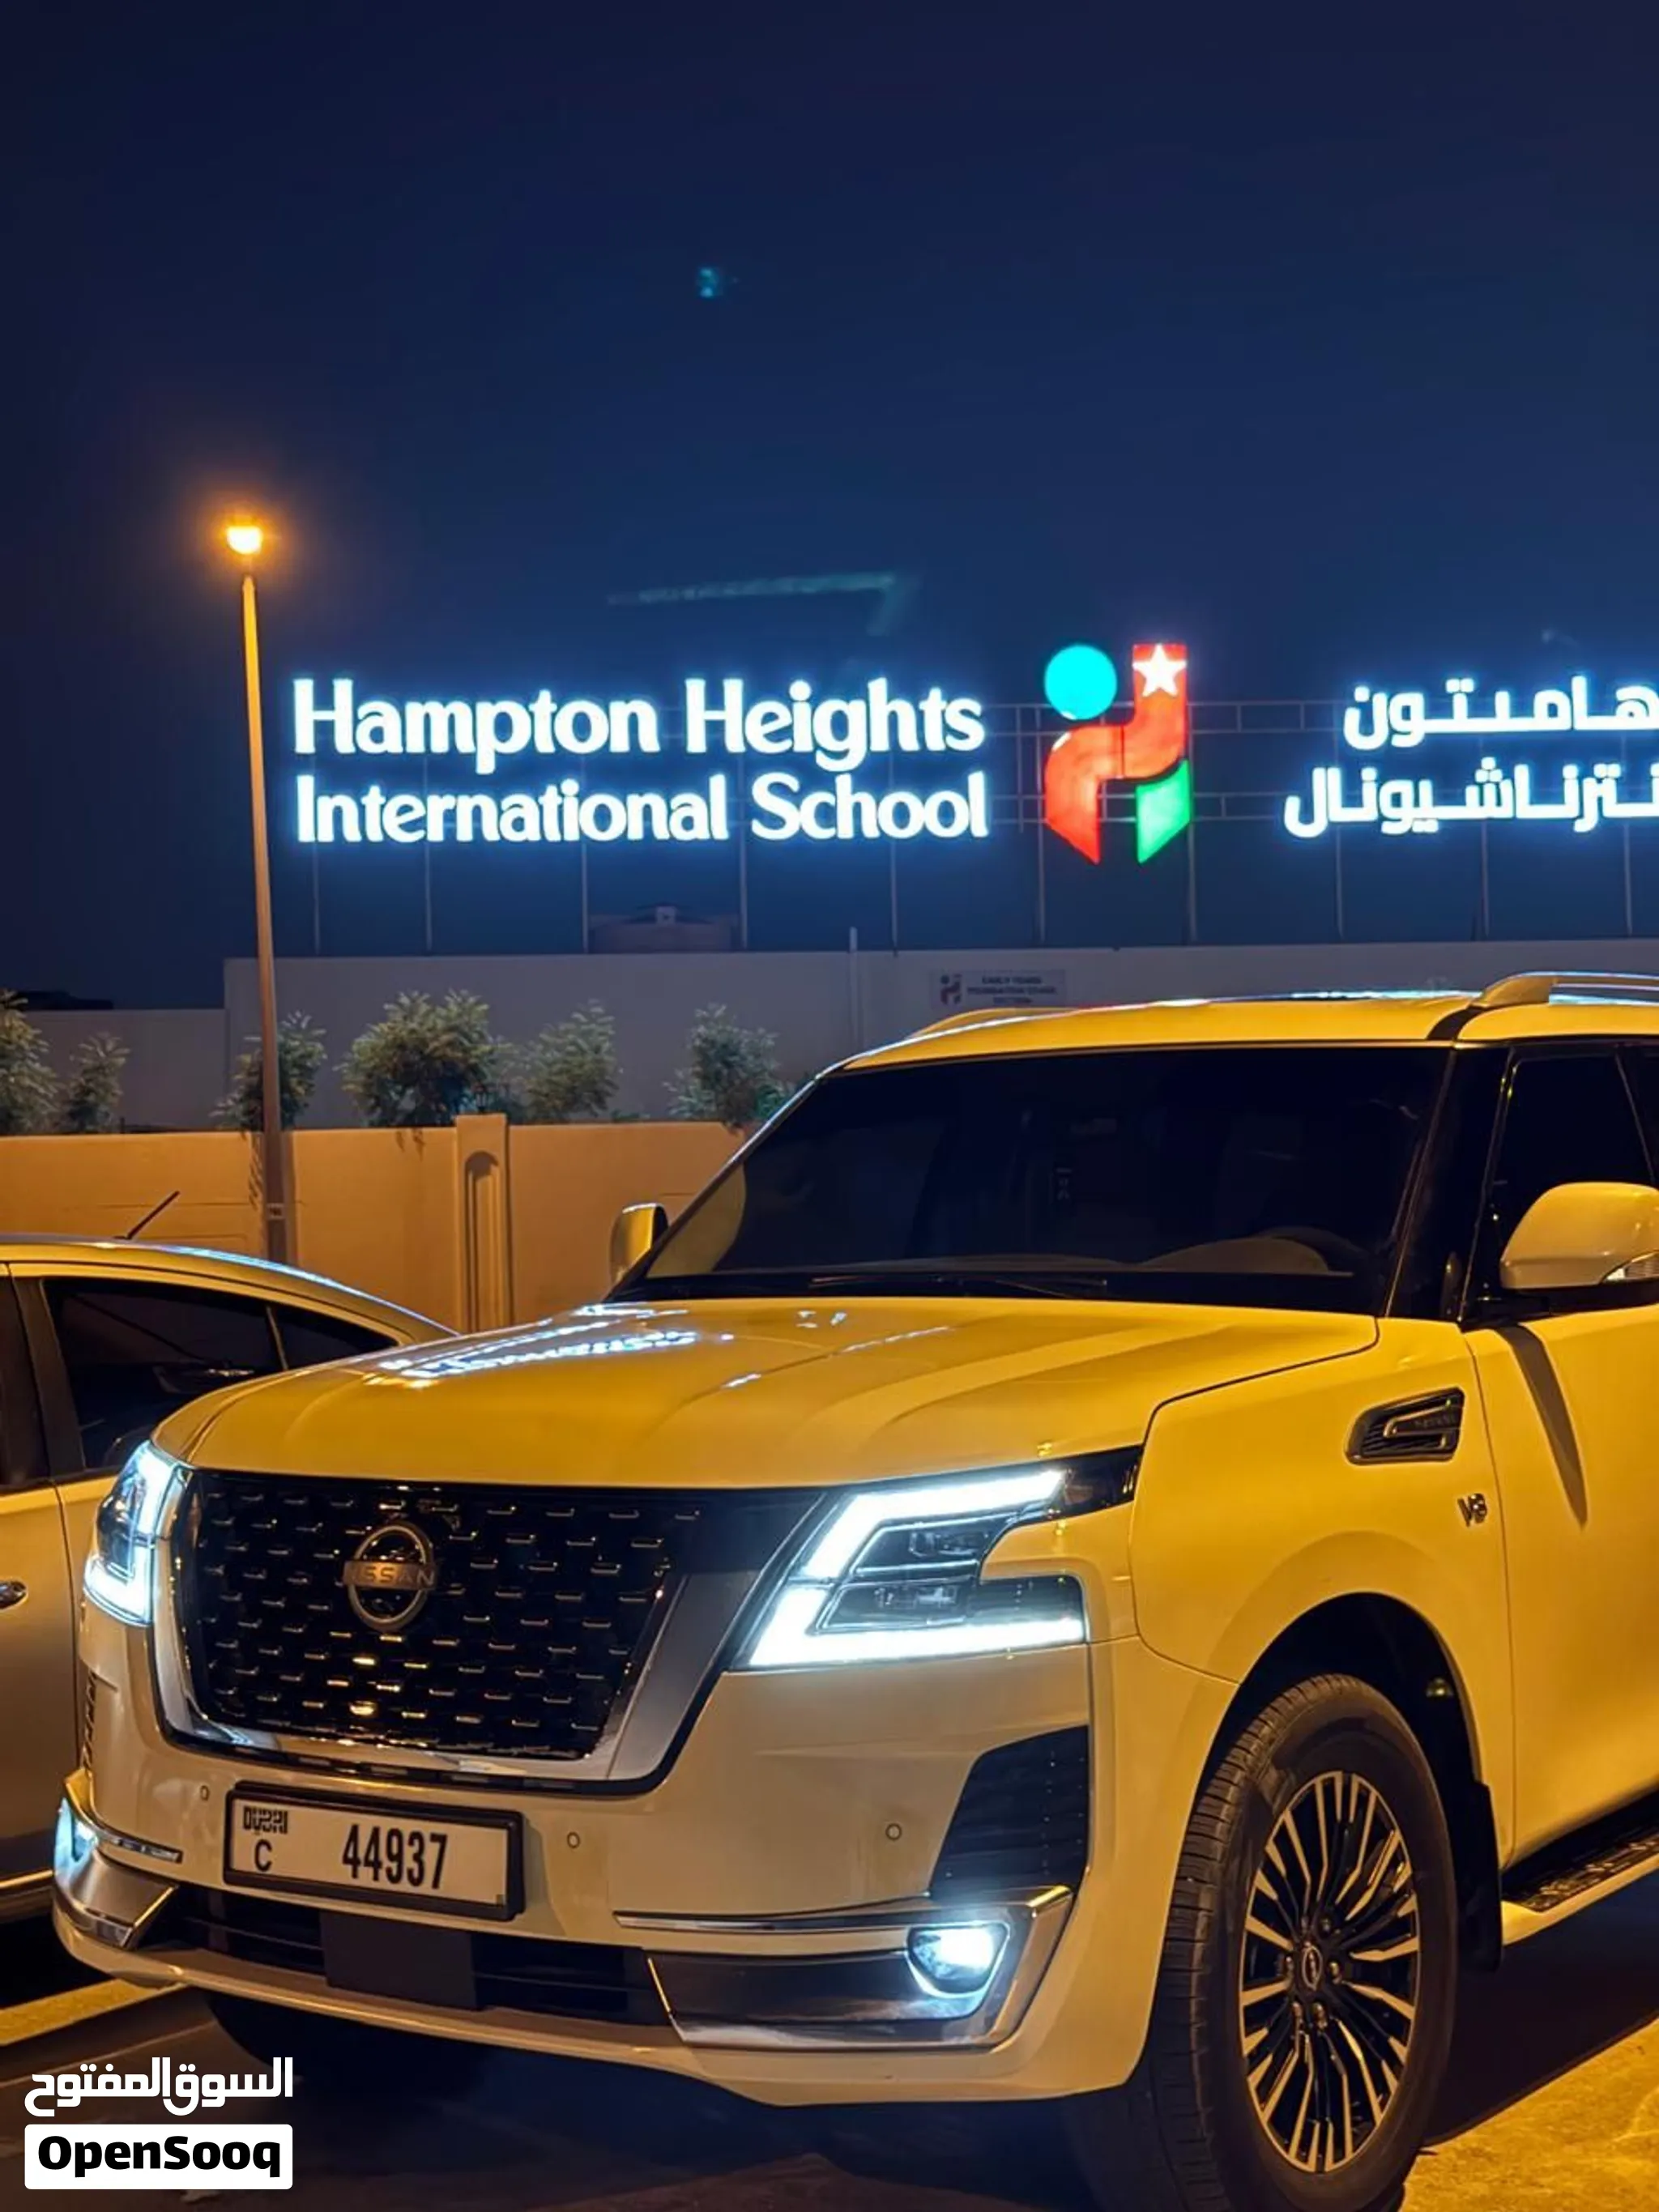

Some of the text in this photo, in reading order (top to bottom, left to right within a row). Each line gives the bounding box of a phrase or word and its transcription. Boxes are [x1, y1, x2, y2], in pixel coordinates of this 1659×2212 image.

[294, 677, 985, 774] Hampton Heights
[296, 770, 989, 843] International School
[1457, 1493, 1487, 1528] V8
[254, 1823, 449, 1890] C 44937
